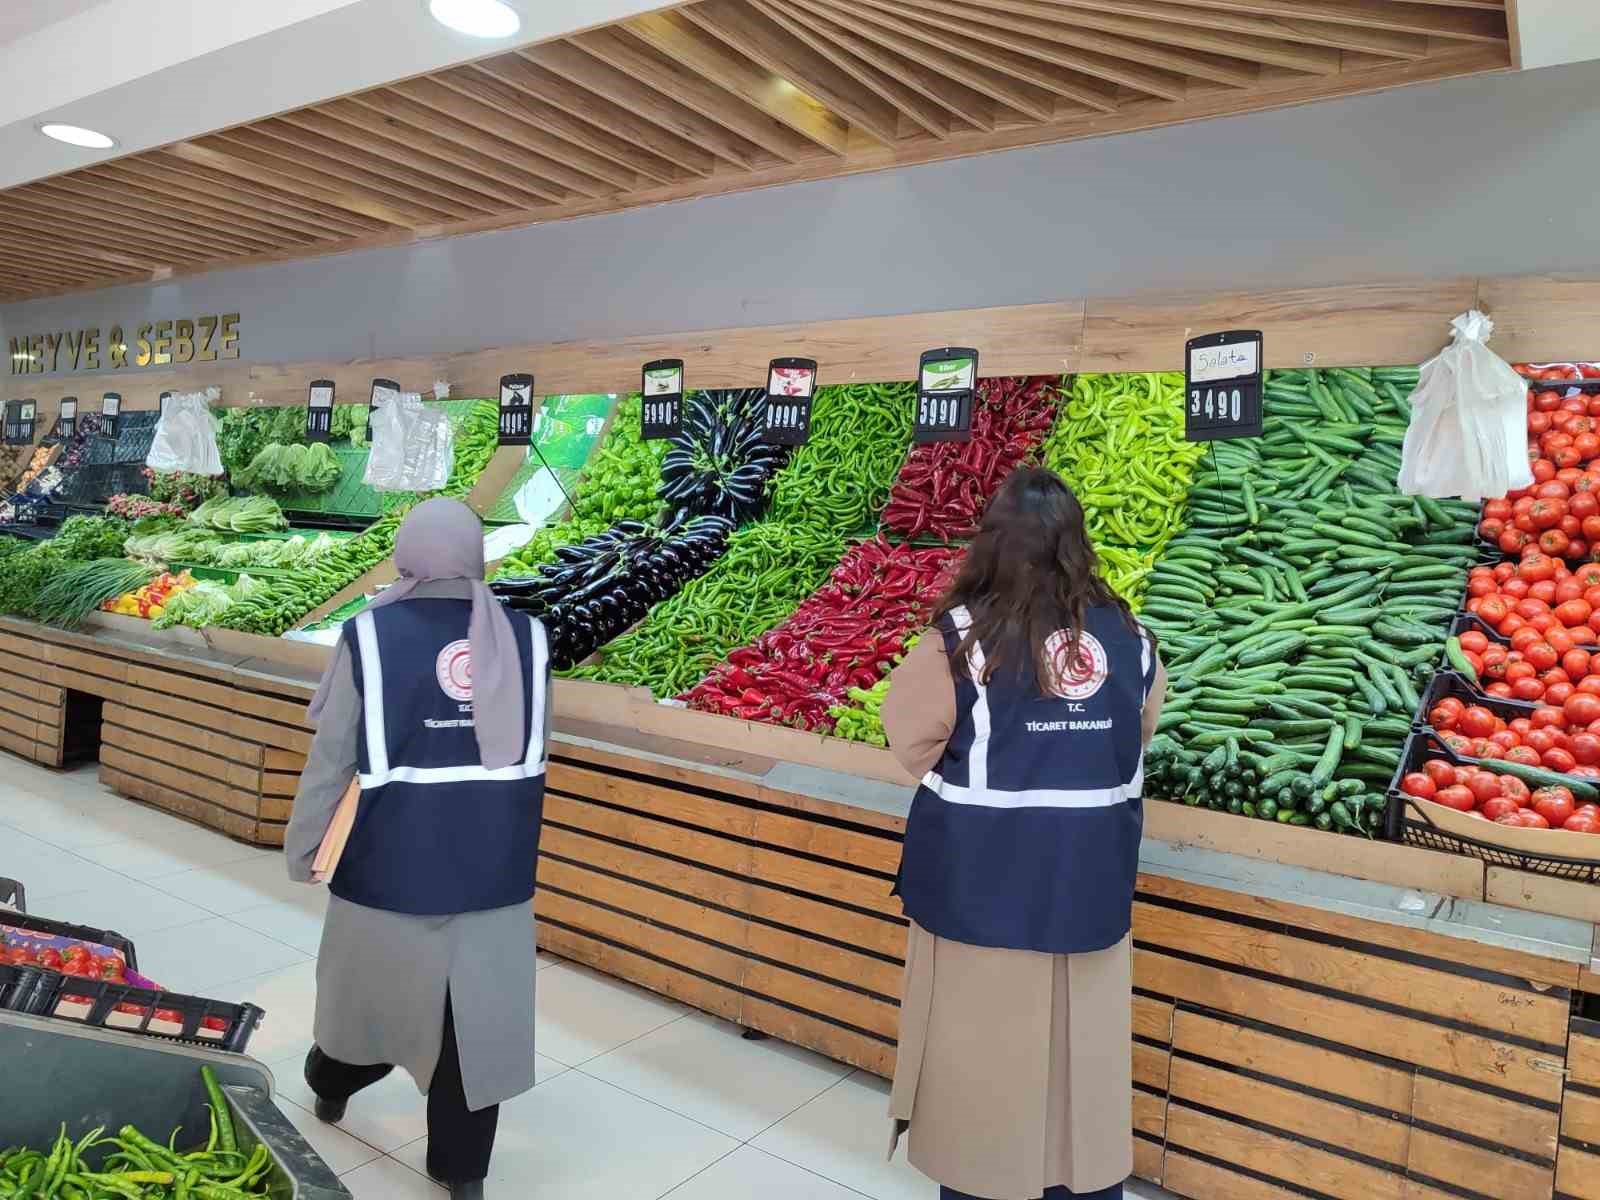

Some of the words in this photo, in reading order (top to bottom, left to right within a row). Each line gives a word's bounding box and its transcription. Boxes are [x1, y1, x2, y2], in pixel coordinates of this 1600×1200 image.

[9, 328, 100, 375] MEYVE
[109, 324, 128, 369] &
[135, 312, 241, 367] SEBZE
[644, 401, 672, 425] 5990
[920, 397, 957, 427] 5990
[1191, 388, 1241, 421] 3490
[1025, 720, 1068, 732] TİCARET
